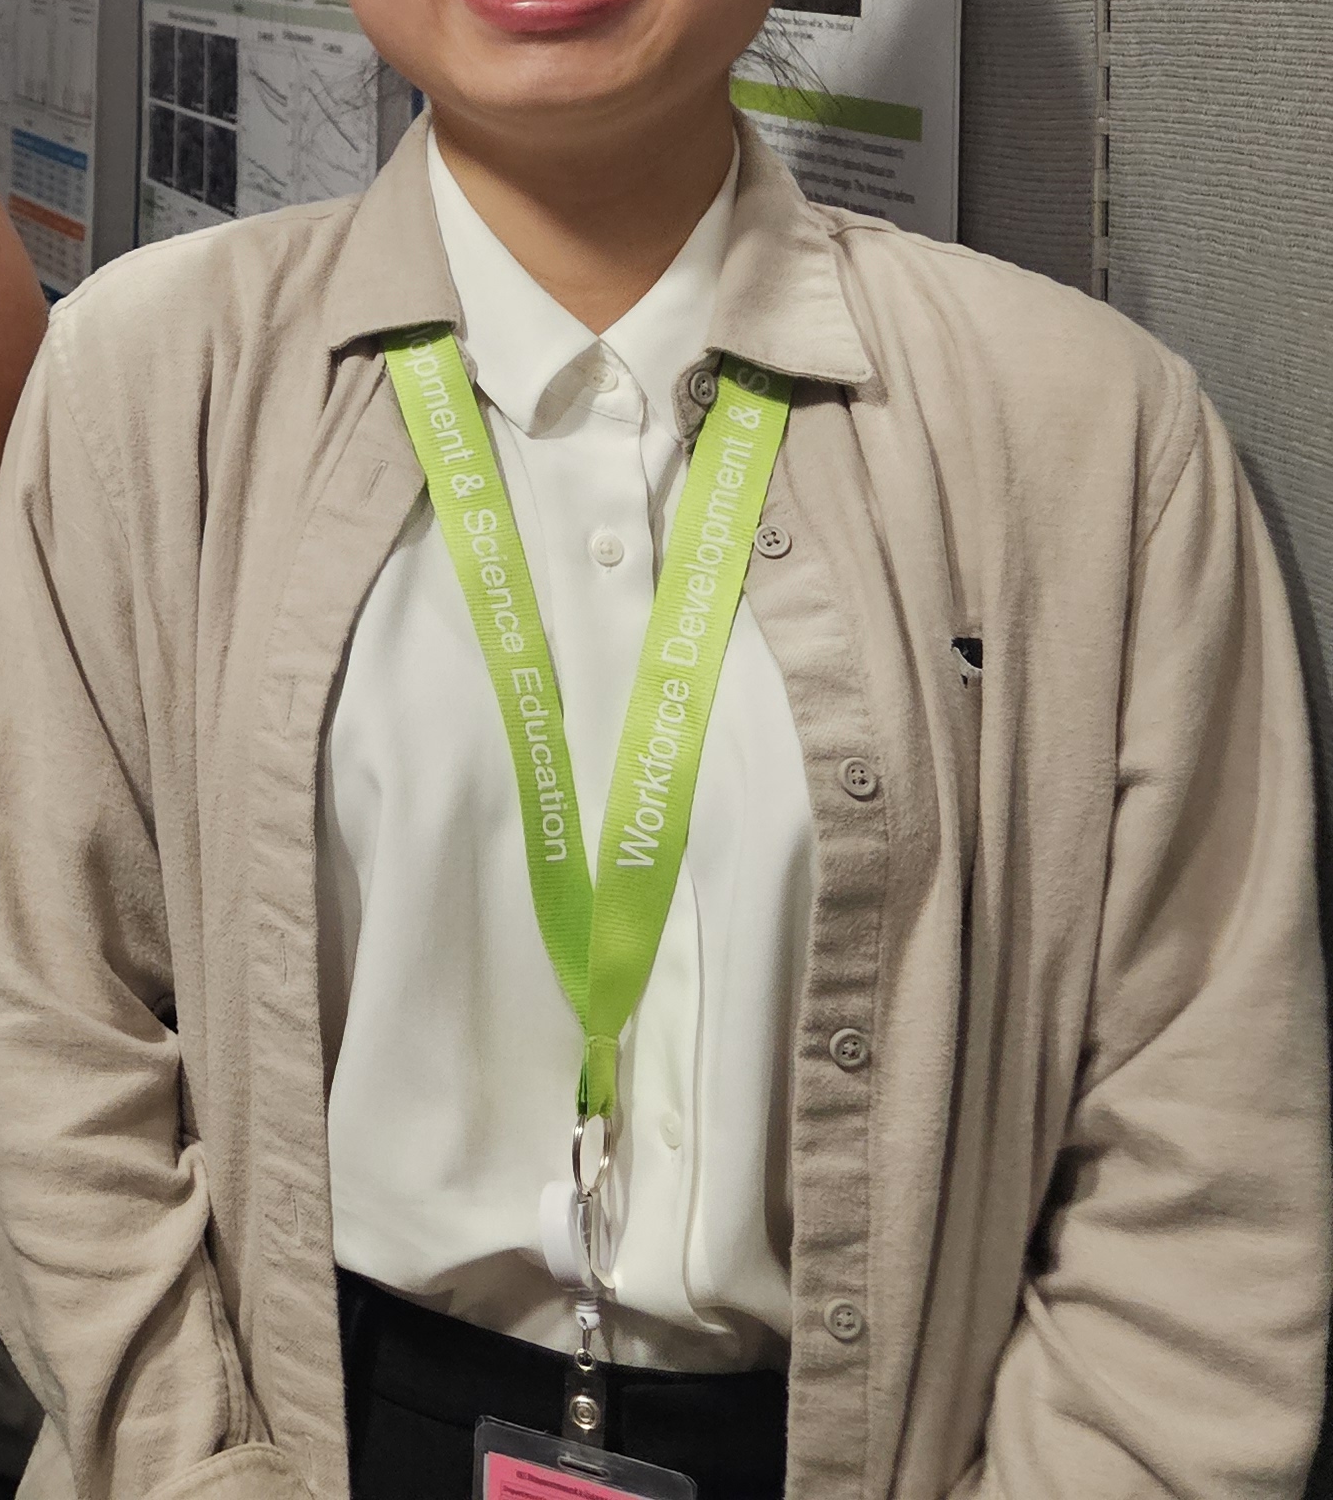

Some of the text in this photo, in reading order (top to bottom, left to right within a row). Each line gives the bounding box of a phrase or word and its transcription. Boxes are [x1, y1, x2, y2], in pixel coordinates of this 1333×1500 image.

[450, 472, 486, 500] &
[462, 508, 525, 656] Science
[615, 677, 692, 871] Workforce
[660, 434, 755, 668] Development
[727, 404, 762, 432] &
[510, 666, 569, 864] Education
